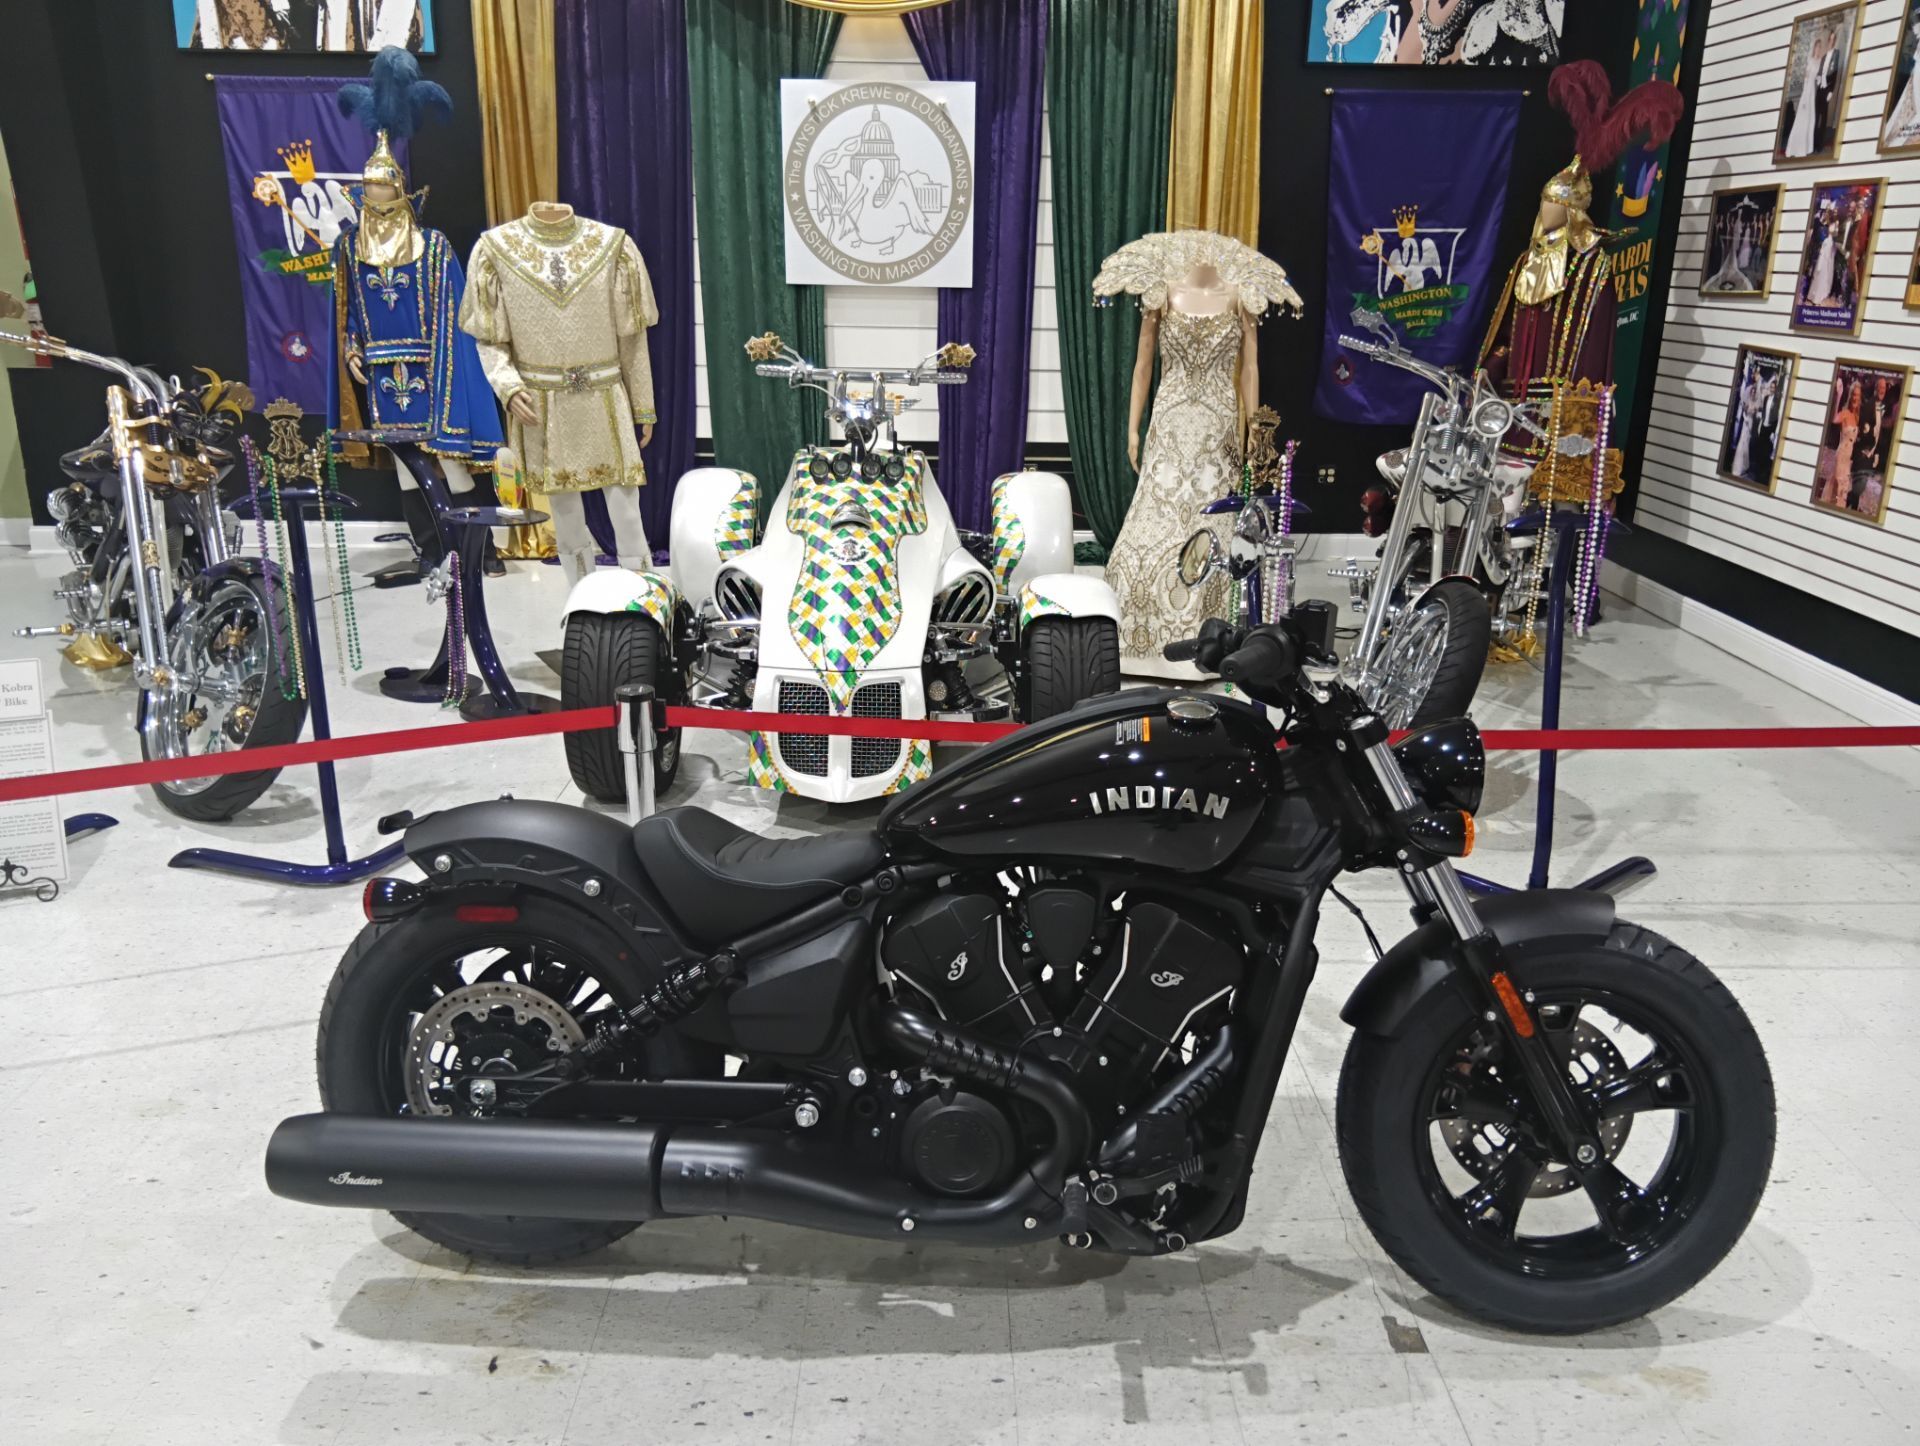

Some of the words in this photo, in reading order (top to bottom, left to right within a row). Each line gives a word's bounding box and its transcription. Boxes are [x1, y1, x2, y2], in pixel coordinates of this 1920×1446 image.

[840, 86, 892, 105] KREWE
[895, 92, 911, 104] of
[793, 98, 840, 156] MYSTICK
[911, 96, 969, 190] LOUISIANIANS
[788, 160, 802, 186] The
[793, 206, 881, 281] WASHINGTON
[885, 254, 935, 280] MARDI
[934, 209, 964, 253] GRAS
[280, 251, 330, 273] WASHI
[1614, 265, 1649, 302] RAS
[1378, 287, 1452, 311] WASHINGTON
[1, 683, 33, 693] Kobra
[1088, 785, 1230, 820] INDIAN
[333, 1171, 379, 1186] Indian
